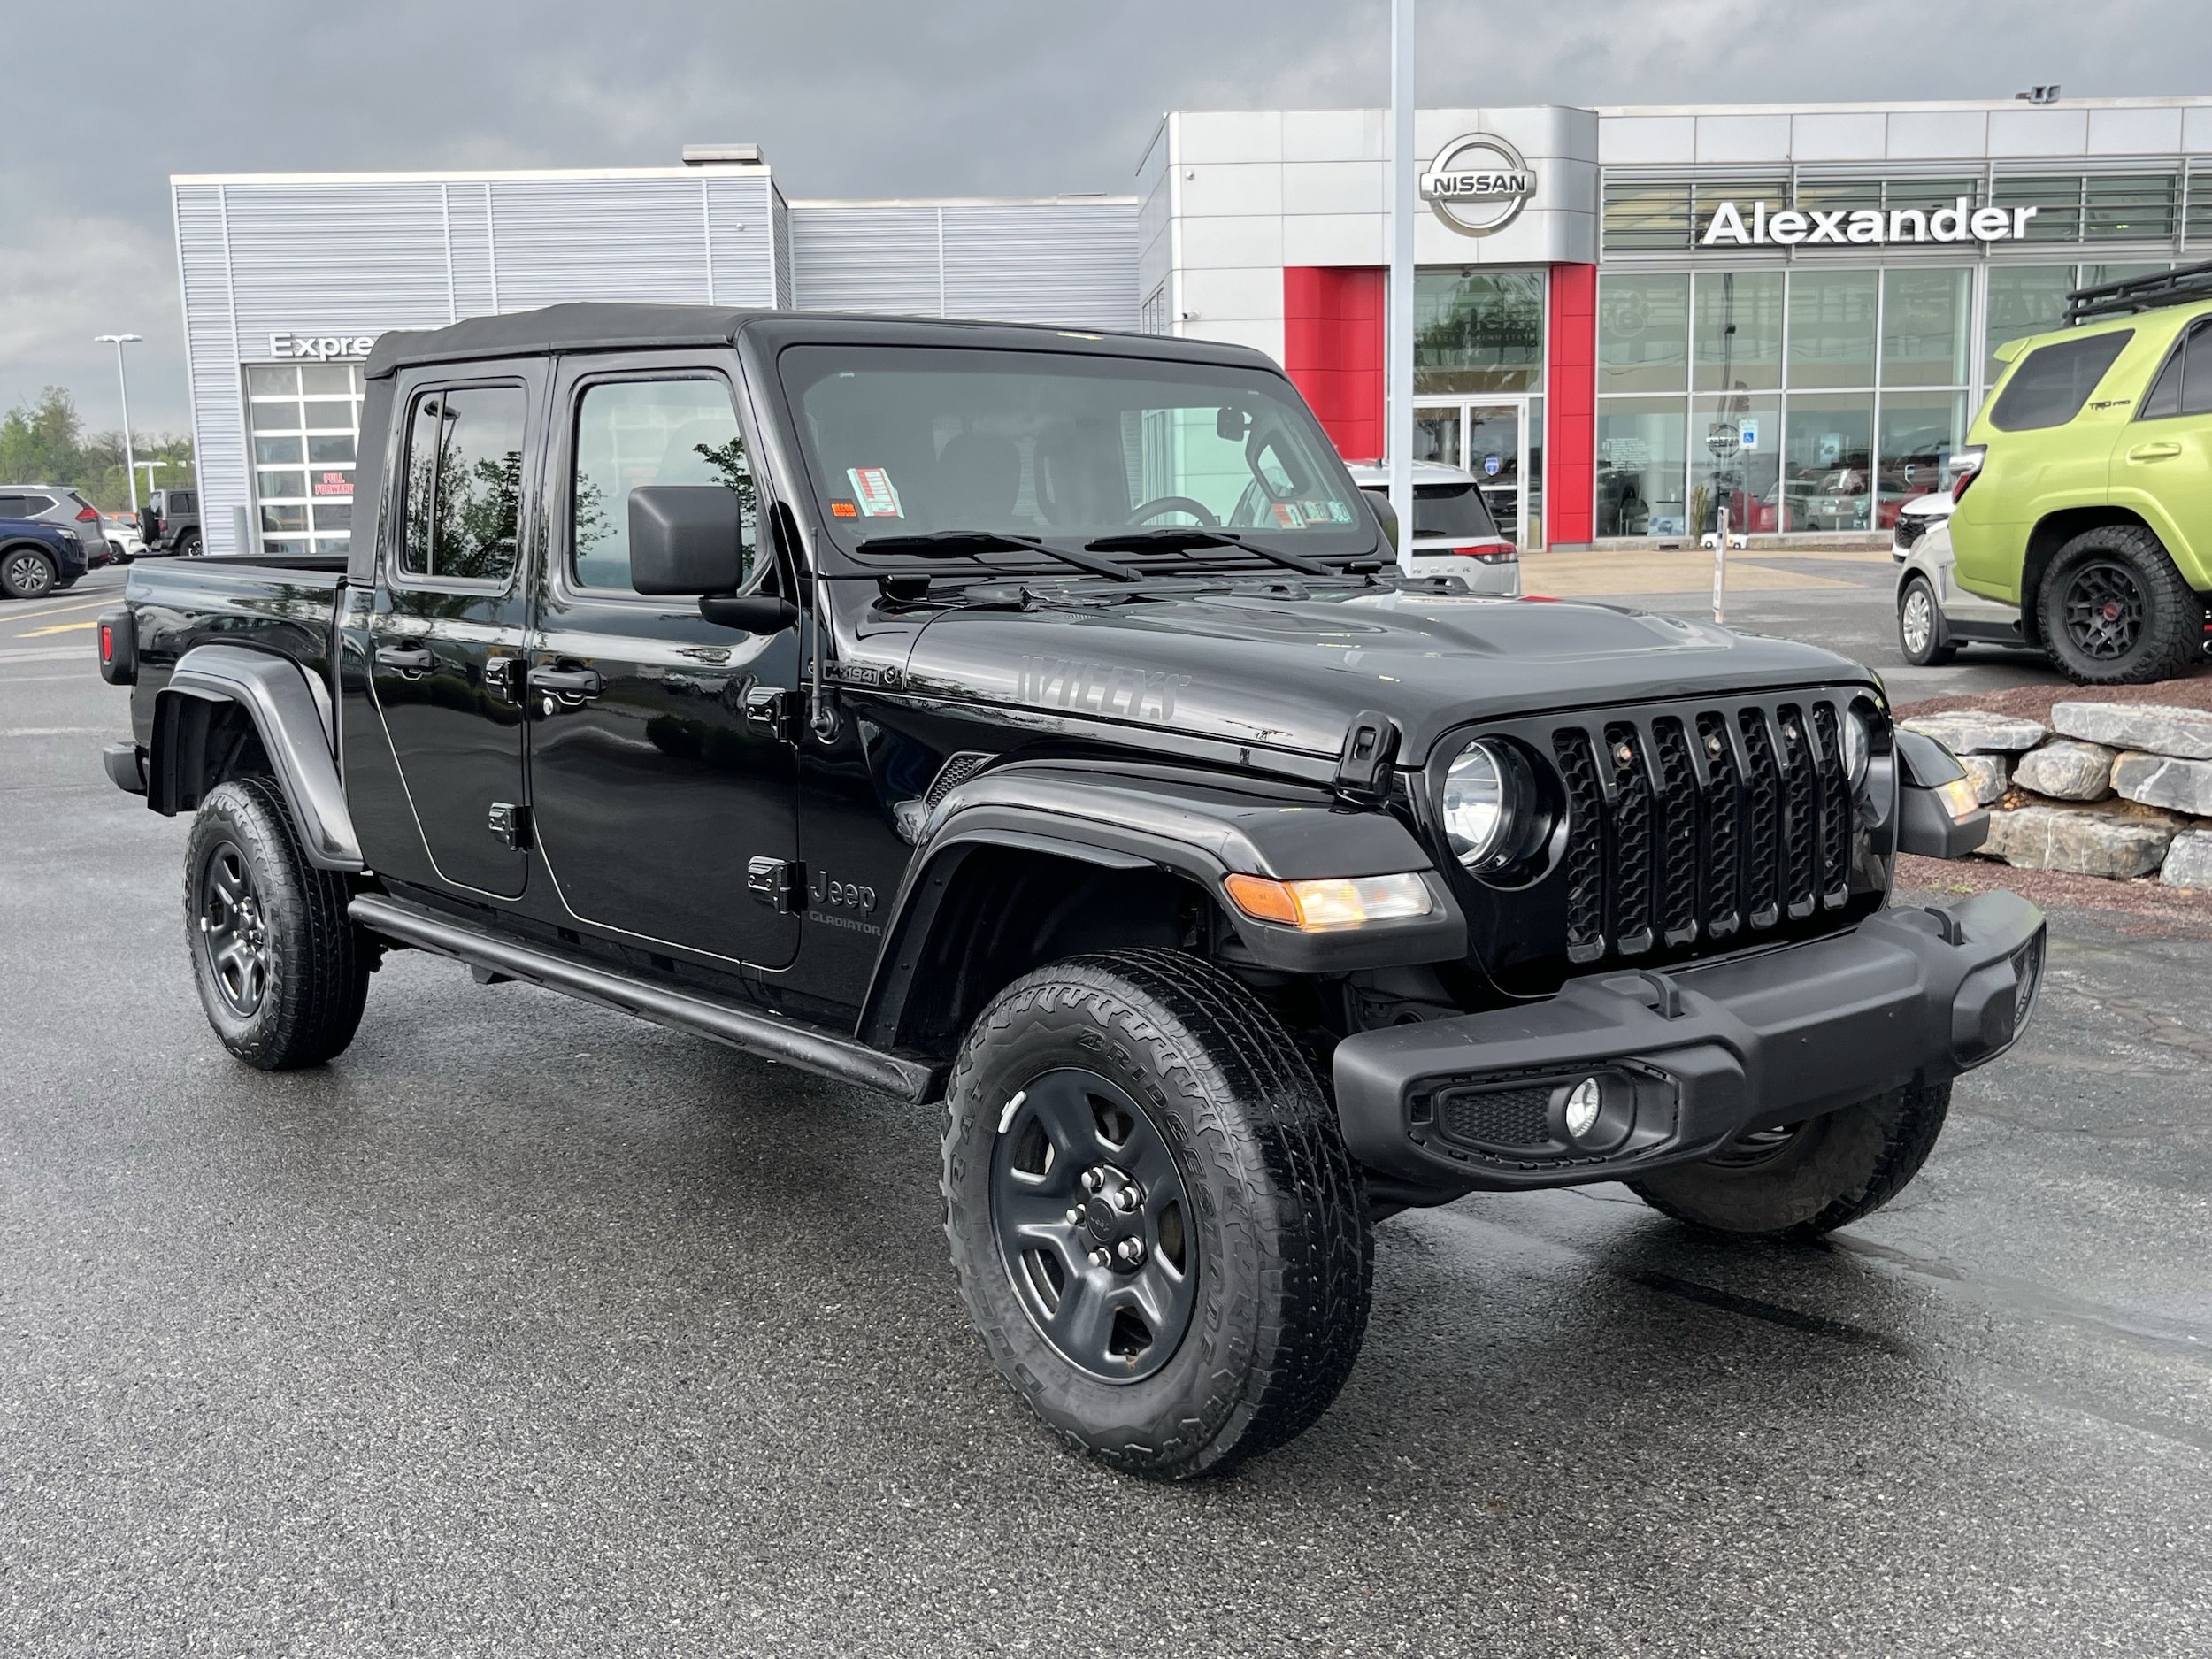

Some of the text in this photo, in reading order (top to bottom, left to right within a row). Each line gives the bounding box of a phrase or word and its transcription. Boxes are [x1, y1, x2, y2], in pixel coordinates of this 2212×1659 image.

[1433, 175, 1525, 194] NISSAN
[1701, 196, 2037, 245] Alexander
[324, 472, 345, 484] PULL
[849, 666, 879, 683] 1941
[1018, 655, 1193, 721] WILLYS
[810, 870, 876, 918] Jeep
[809, 910, 882, 937] GLADIATOR
[1075, 1025, 1226, 1367] BRIDGESTONE
